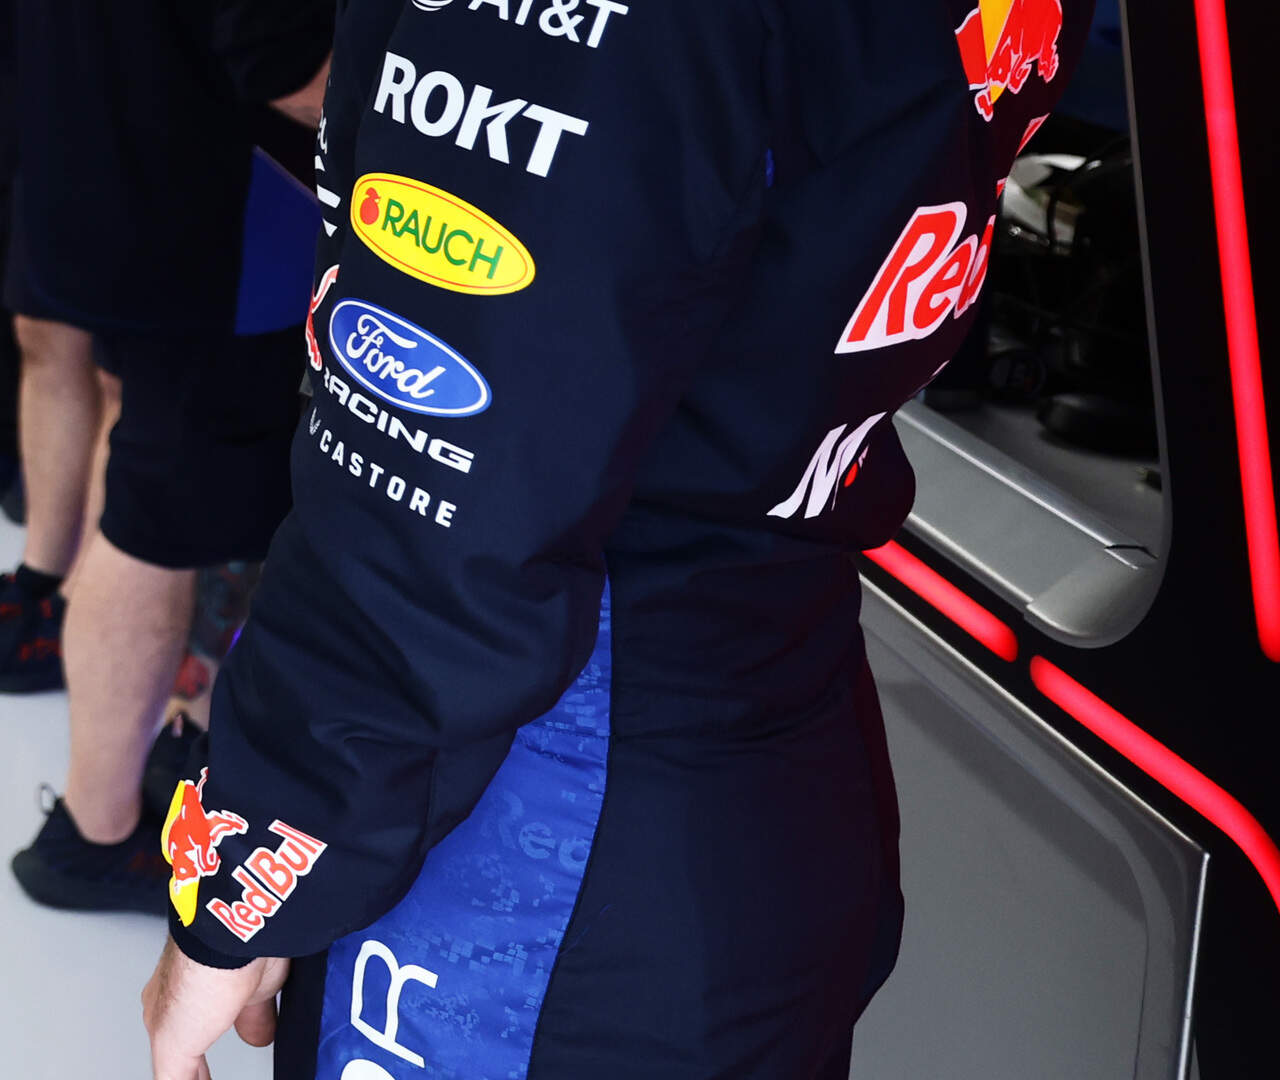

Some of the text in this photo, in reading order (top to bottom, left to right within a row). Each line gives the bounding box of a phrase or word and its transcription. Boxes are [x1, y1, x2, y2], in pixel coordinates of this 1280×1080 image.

[373, 51, 589, 178] ROKT
[382, 198, 503, 279] RAUCH
[346, 314, 446, 399] Ford
[320, 429, 457, 528] CASTORE
[206, 820, 327, 942] Red Bull
